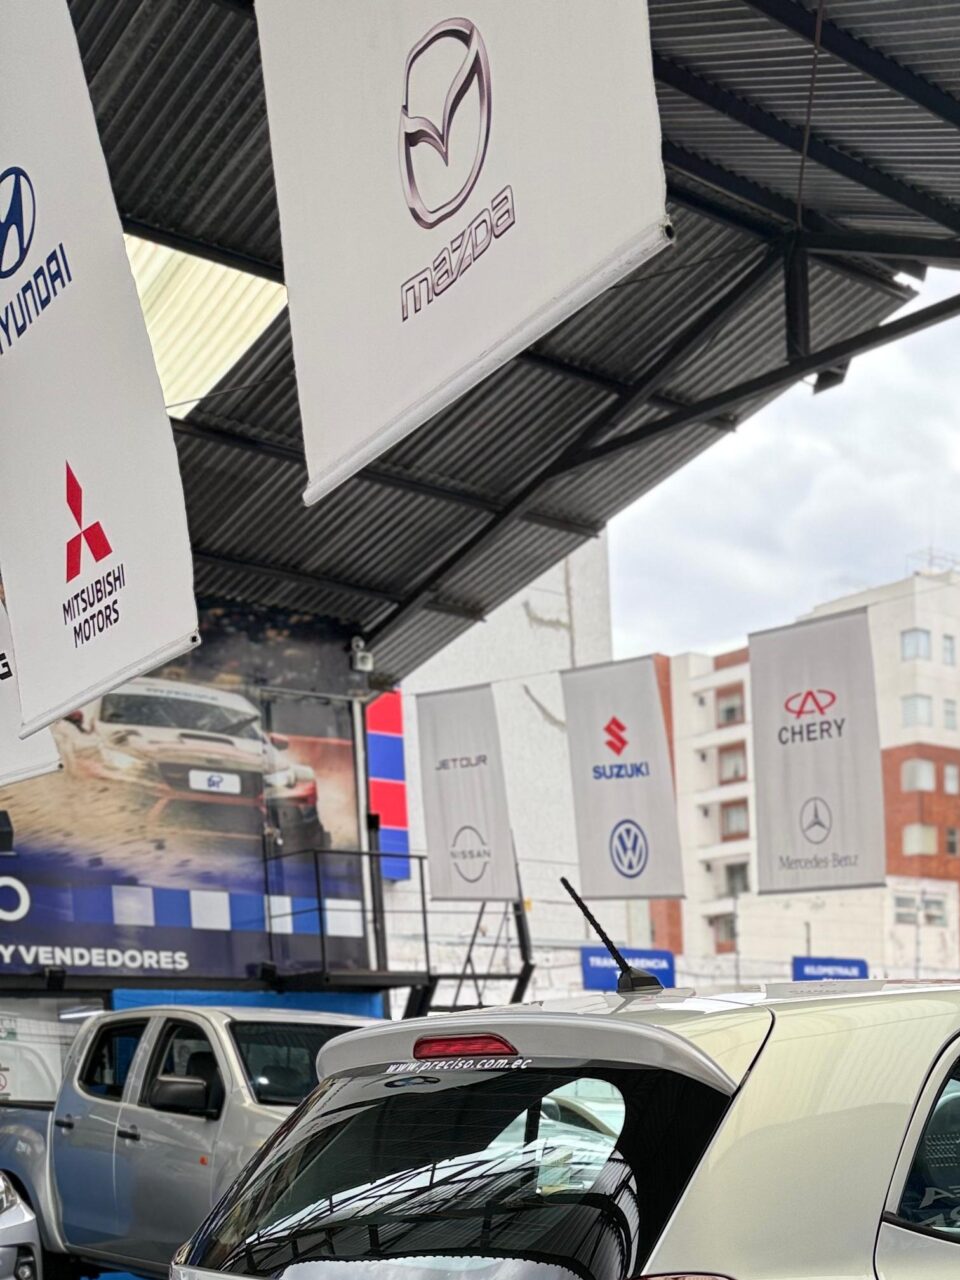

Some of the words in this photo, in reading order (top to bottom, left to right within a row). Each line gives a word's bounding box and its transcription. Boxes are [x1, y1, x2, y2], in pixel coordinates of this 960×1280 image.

[401, 185, 516, 322] mazda
[0, 242, 72, 354] YUNDAI
[62, 563, 126, 626] MITSUBISHI
[73, 598, 120, 648] MOTORS
[778, 718, 845, 745] CHERY
[435, 754, 488, 771] JETOUR
[592, 761, 650, 780] SUZUKI
[450, 849, 491, 860] NISSAN
[779, 853, 859, 872] Mercedes-Benz
[19, 946, 190, 970] VENDEDORES
[386, 1057, 533, 1074] www.preciso.com.ec
